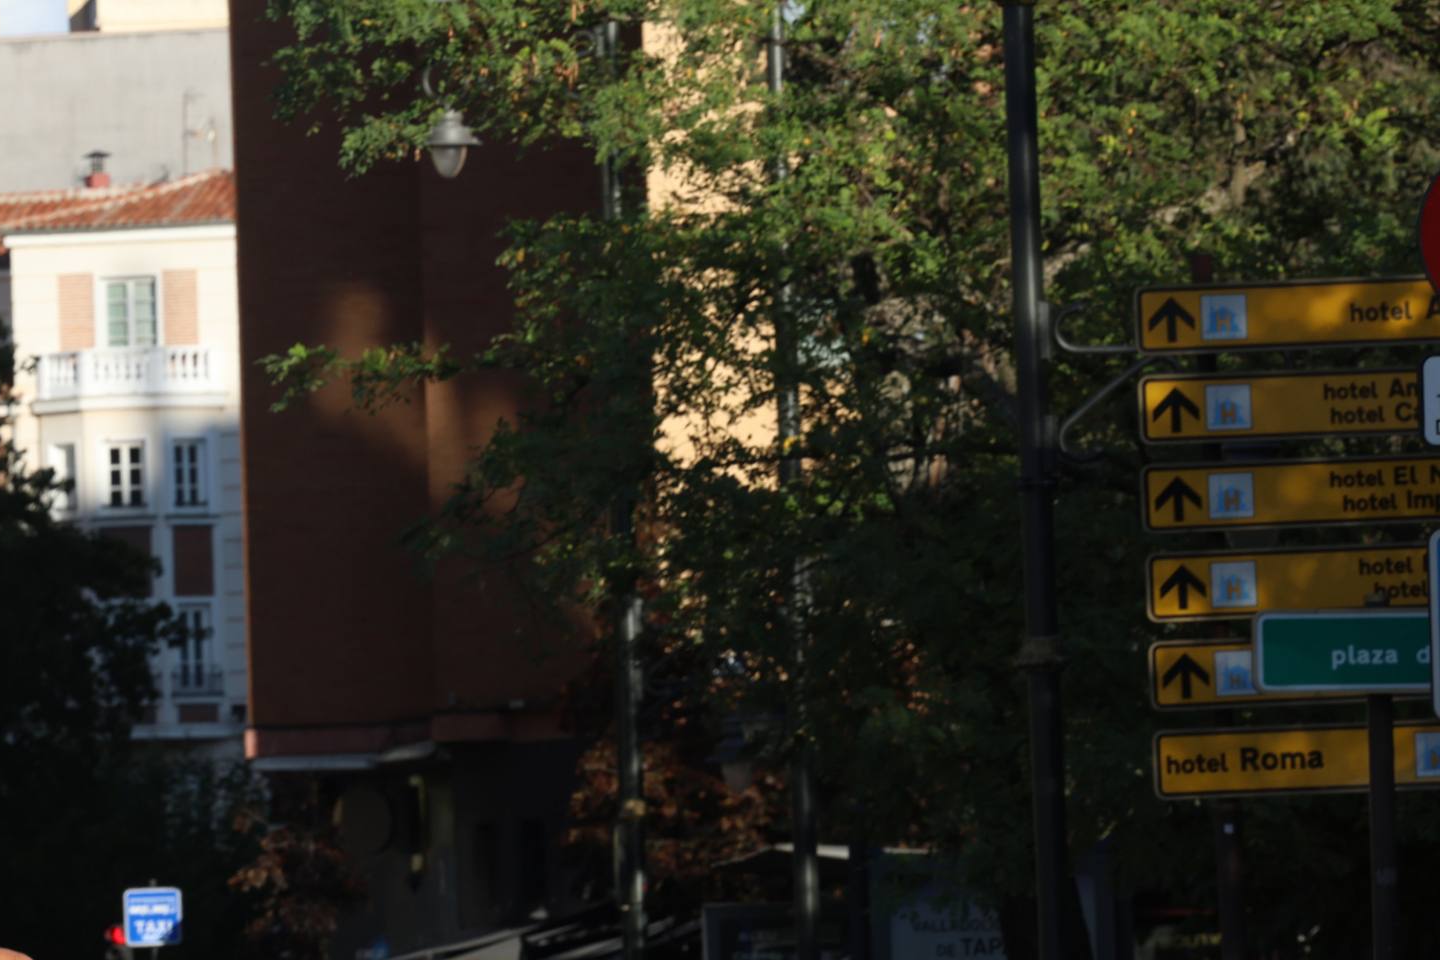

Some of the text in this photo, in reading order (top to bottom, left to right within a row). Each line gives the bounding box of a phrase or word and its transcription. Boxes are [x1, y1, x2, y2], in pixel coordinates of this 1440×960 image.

[1349, 301, 1412, 323] hotel
[1323, 377, 1419, 400] hotel An
[1330, 405, 1384, 425] hotel
[1329, 470, 1385, 489] hotel
[1393, 464, 1418, 485] El
[1343, 493, 1397, 513] hotel
[1359, 556, 1414, 576] hotel
[1331, 644, 1432, 670] plaza d
[1165, 747, 1325, 775] hotel Roma
[960, 937, 1005, 957] TAP
